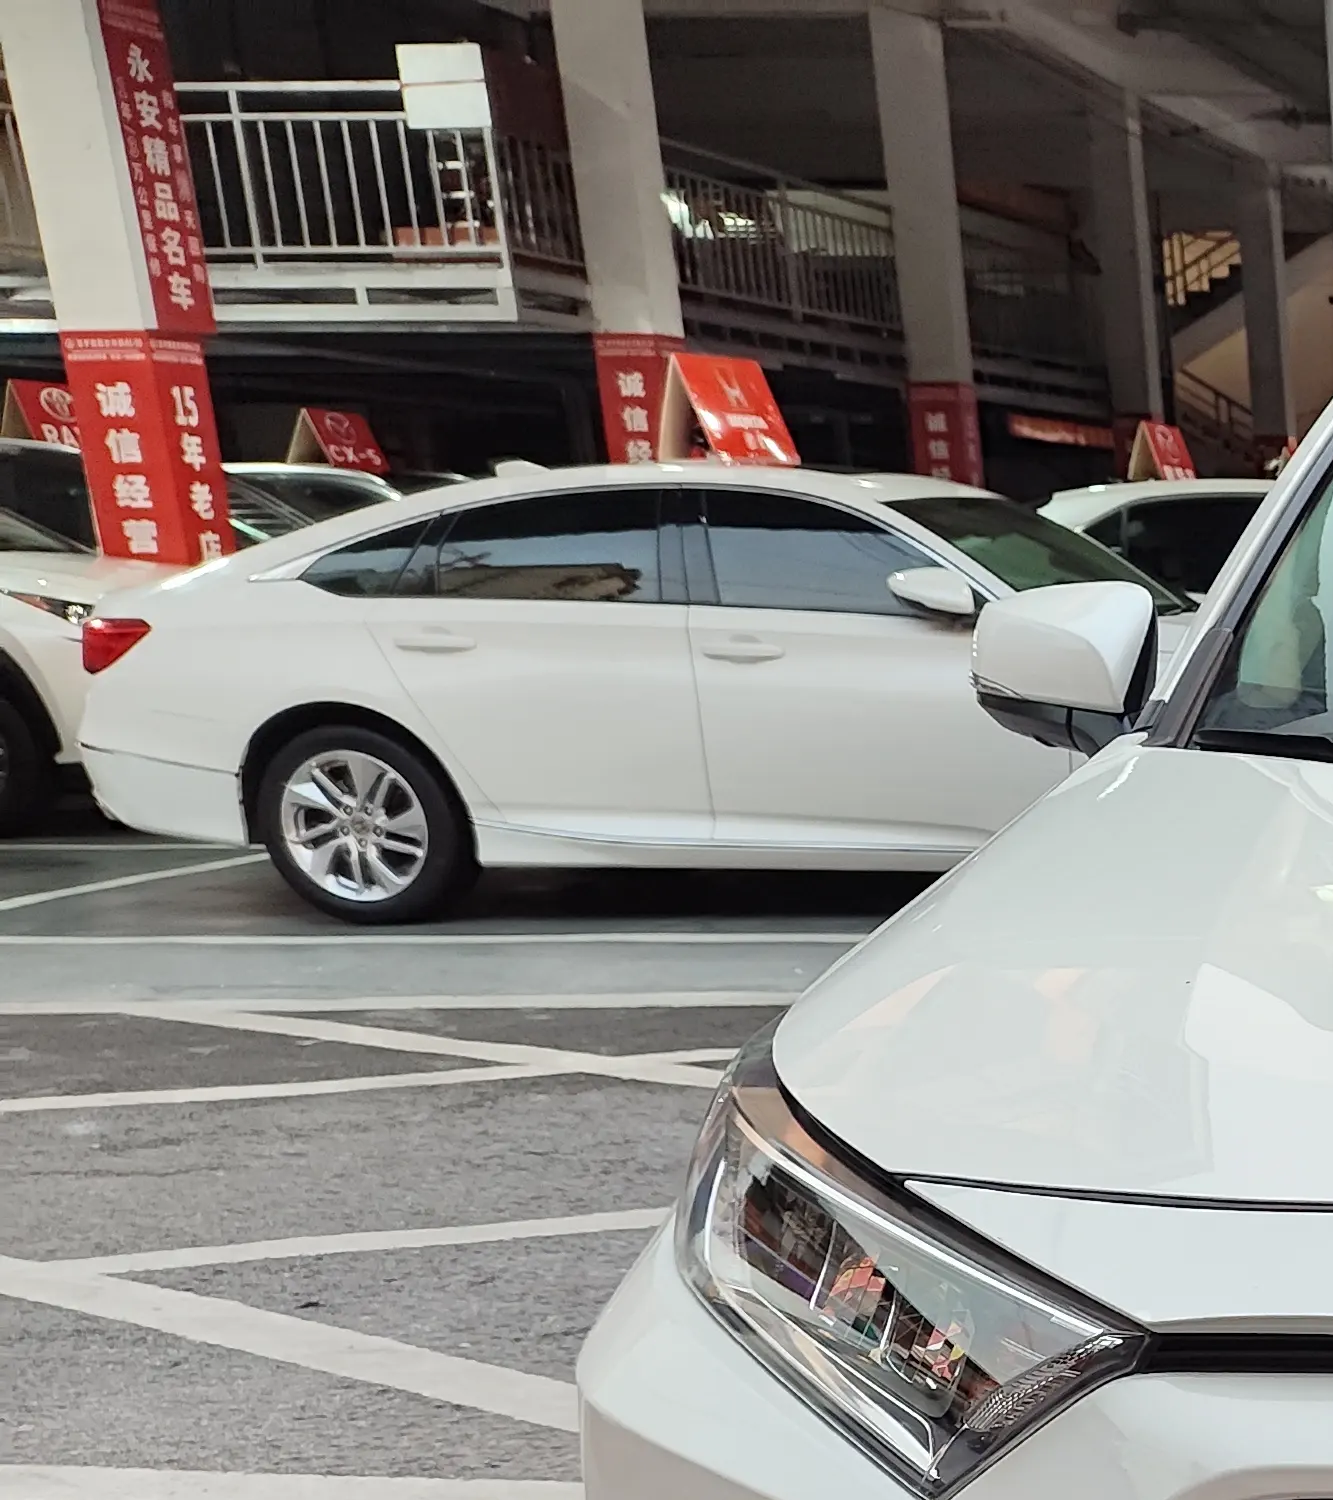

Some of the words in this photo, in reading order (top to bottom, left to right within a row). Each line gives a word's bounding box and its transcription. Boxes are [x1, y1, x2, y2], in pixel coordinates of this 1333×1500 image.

[126, 42, 195, 311] 永安精品名车
[40, 423, 81, 448] RA
[94, 381, 159, 555] 诚信经营
[327, 444, 382, 466] CX-5
